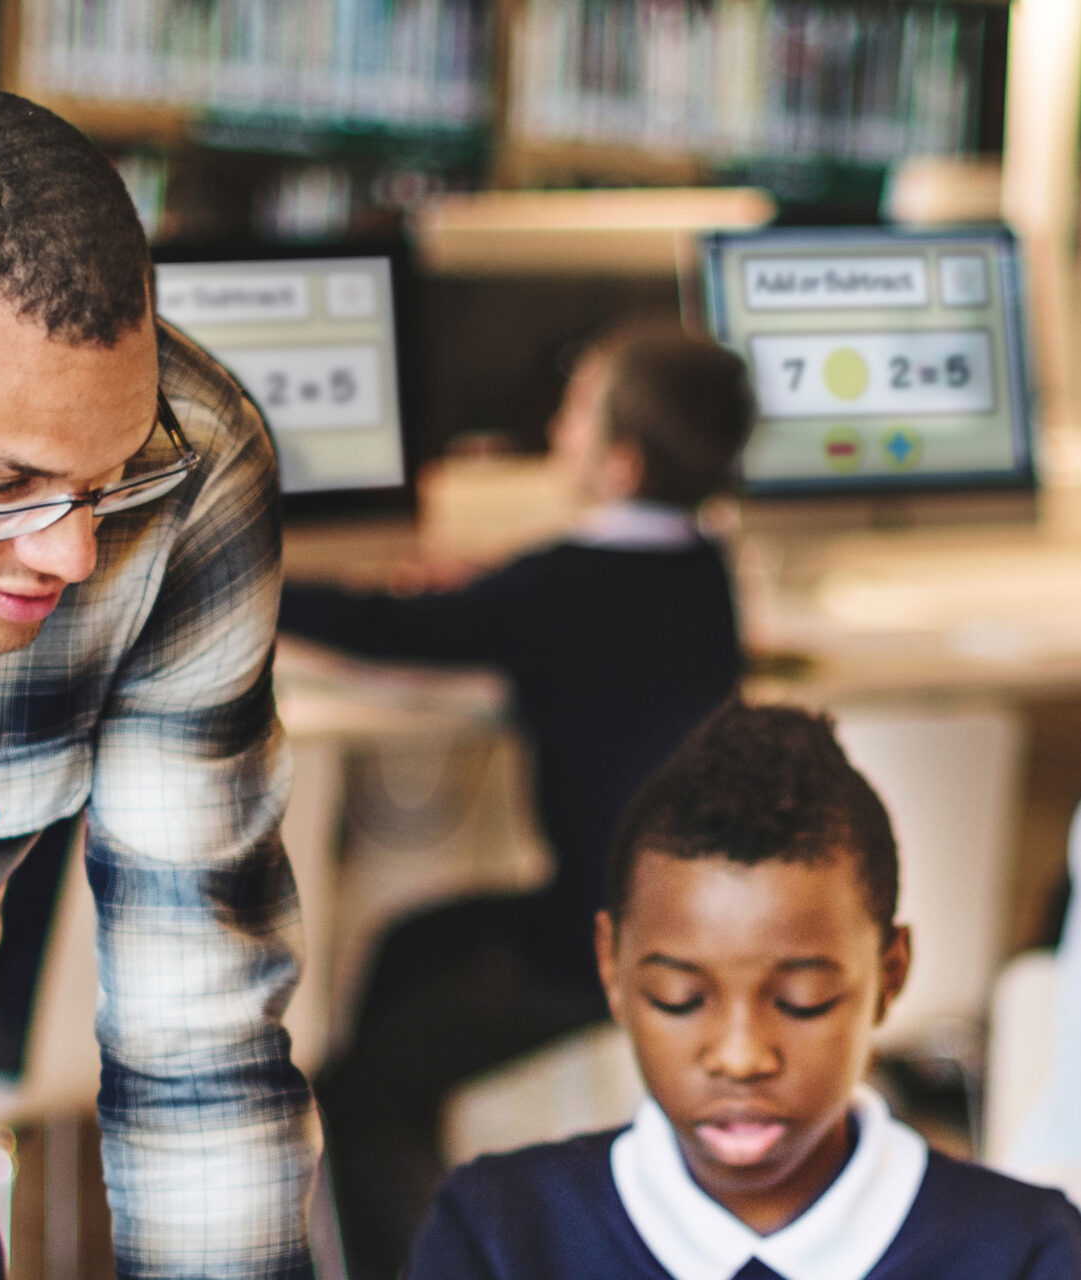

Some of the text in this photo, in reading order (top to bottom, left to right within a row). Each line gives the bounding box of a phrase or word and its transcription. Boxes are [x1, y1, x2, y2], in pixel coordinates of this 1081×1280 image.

[756, 268, 915, 293] Add or Subtract
[265, 371, 288, 406] 2
[329, 369, 357, 405] 5
[781, 357, 806, 391] 7
[889, 356, 912, 389] 2
[945, 354, 971, 389] 5
